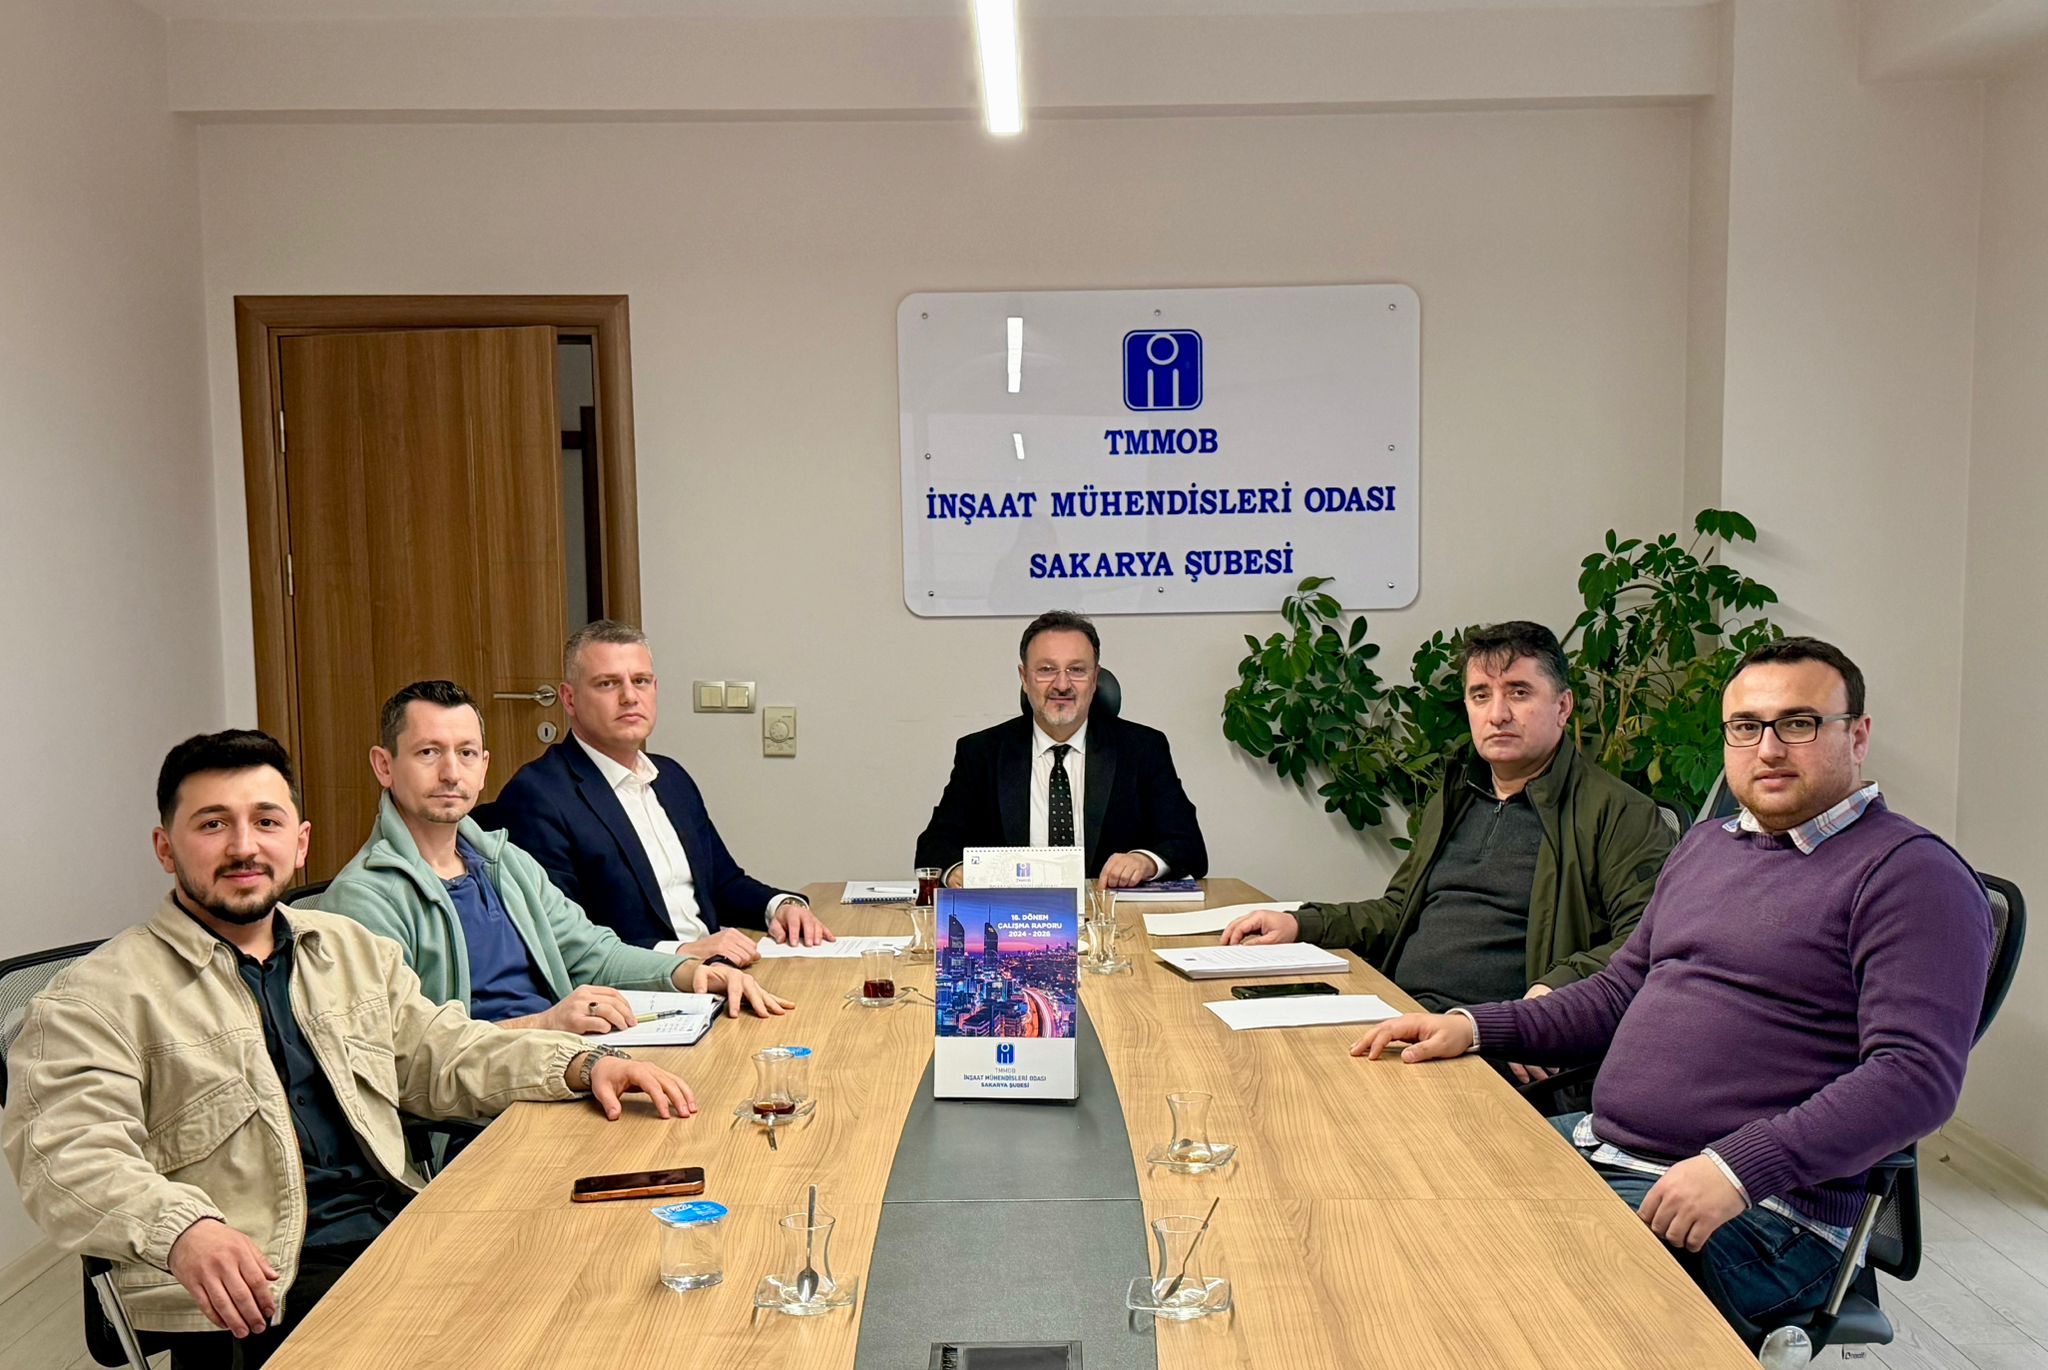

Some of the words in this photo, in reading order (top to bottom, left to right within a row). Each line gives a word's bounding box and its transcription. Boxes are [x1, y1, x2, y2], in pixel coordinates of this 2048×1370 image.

[1104, 428, 1219, 455] TMMOB
[926, 487, 1037, 525] İNŞAAT
[1051, 481, 1293, 518] MÜHENDİSLERİ
[1305, 486, 1396, 512] ODASI
[1029, 551, 1174, 579] SAKARYA
[1185, 541, 1294, 582] ŞUBESİ
[997, 922, 1030, 930] ÇALIŞMA
[1022, 913, 1049, 921] DÖNEM
